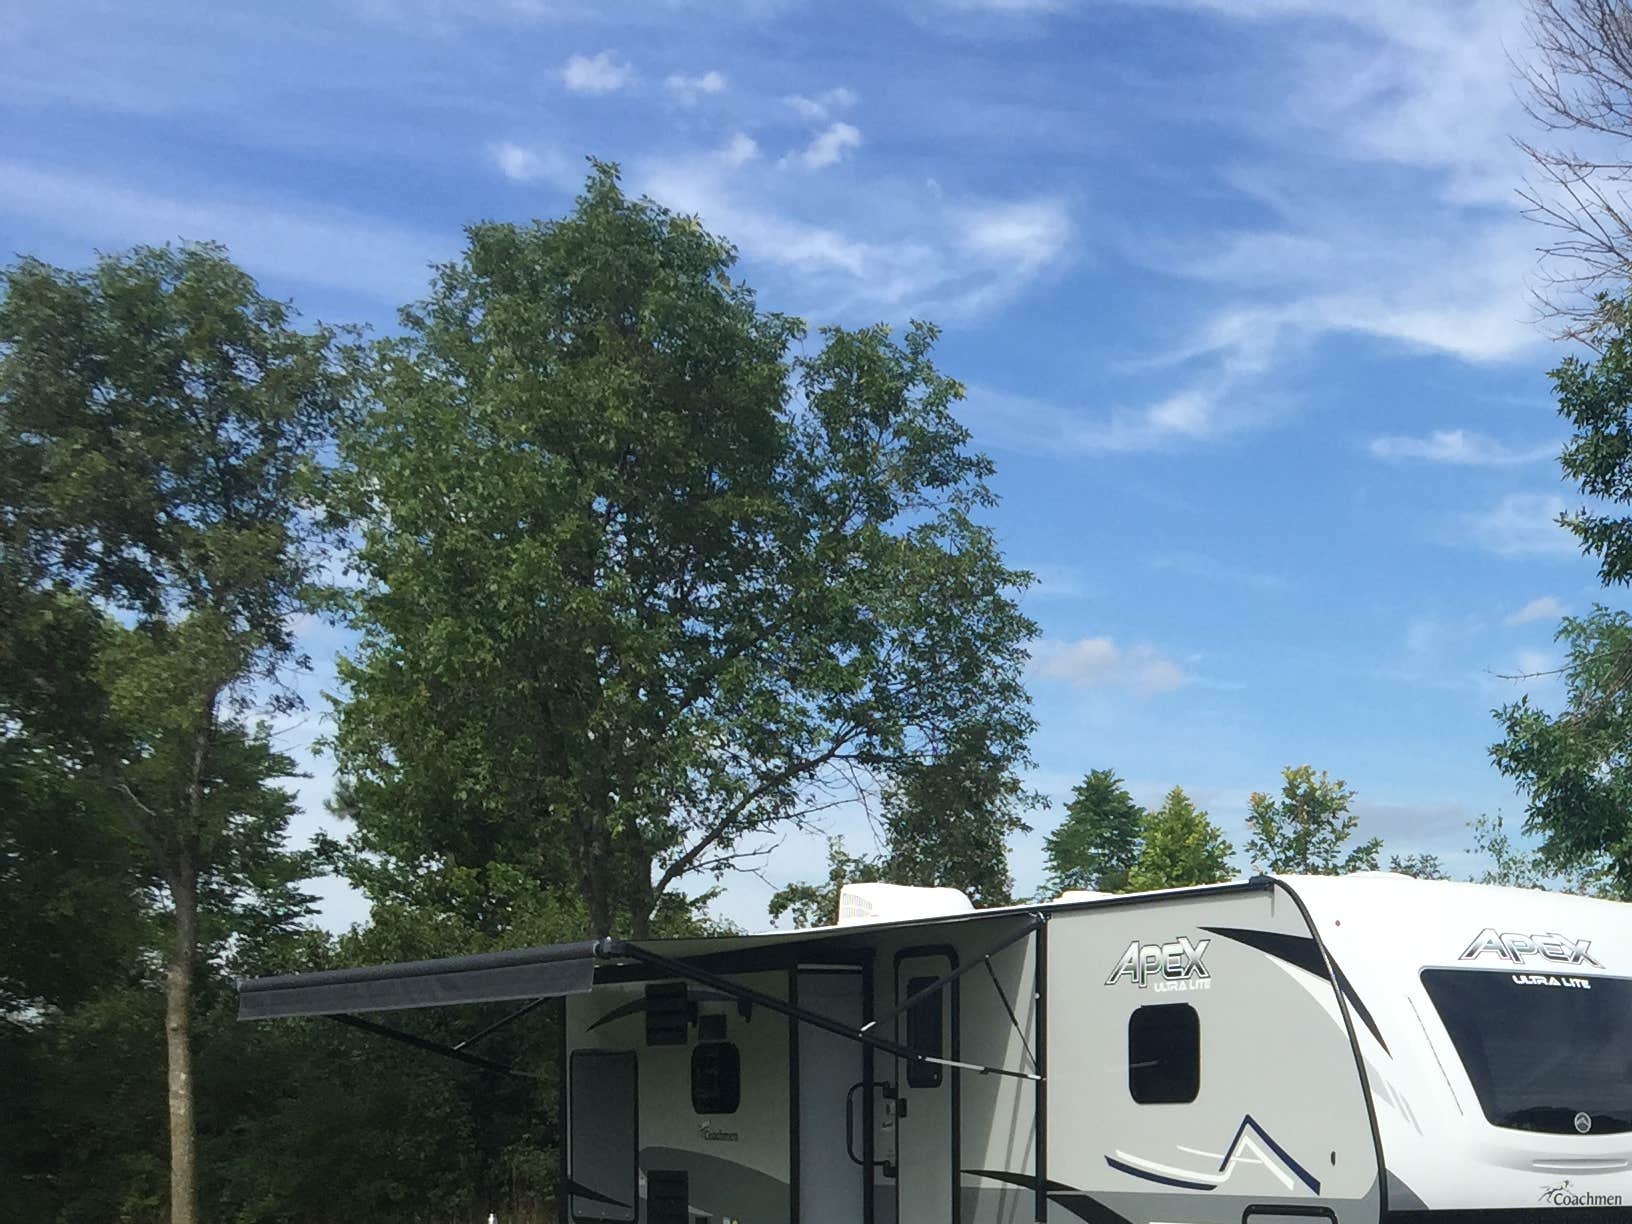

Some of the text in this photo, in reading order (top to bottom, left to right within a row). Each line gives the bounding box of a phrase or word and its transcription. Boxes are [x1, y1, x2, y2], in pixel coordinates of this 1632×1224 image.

[1458, 928, 1606, 969] APEX
[1104, 936, 1211, 988] APEX
[1153, 979, 1211, 992] ULTRA LITE
[1512, 975, 1591, 989] ULTRA LITE
[1554, 1192, 1622, 1206] Coachmen
